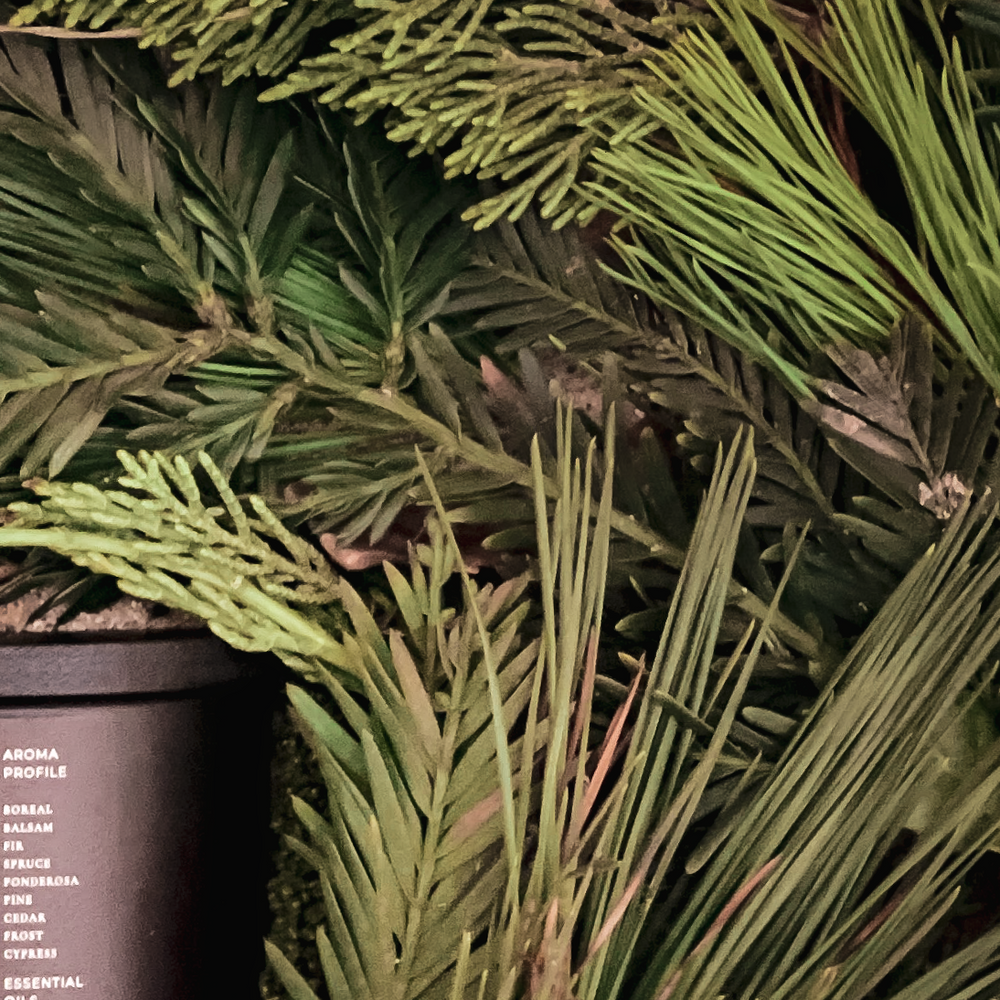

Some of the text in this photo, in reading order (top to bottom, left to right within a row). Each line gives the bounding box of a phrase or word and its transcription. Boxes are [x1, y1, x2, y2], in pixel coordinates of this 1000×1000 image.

[3, 748, 59, 760] AROMA
[4, 766, 67, 779] PROFILE
[3, 804, 53, 815] BOREAL
[4, 822, 53, 833] BALSAM
[4, 841, 24, 851] FIR
[4, 858, 50, 869] SPRUCE
[4, 876, 79, 887] PONDEROSA
[4, 894, 32, 905] PINE
[4, 913, 46, 923] CEDAR
[4, 930, 43, 941] FROST
[4, 948, 57, 959] CYPRESS
[4, 976, 84, 990] ESSENTIAL
